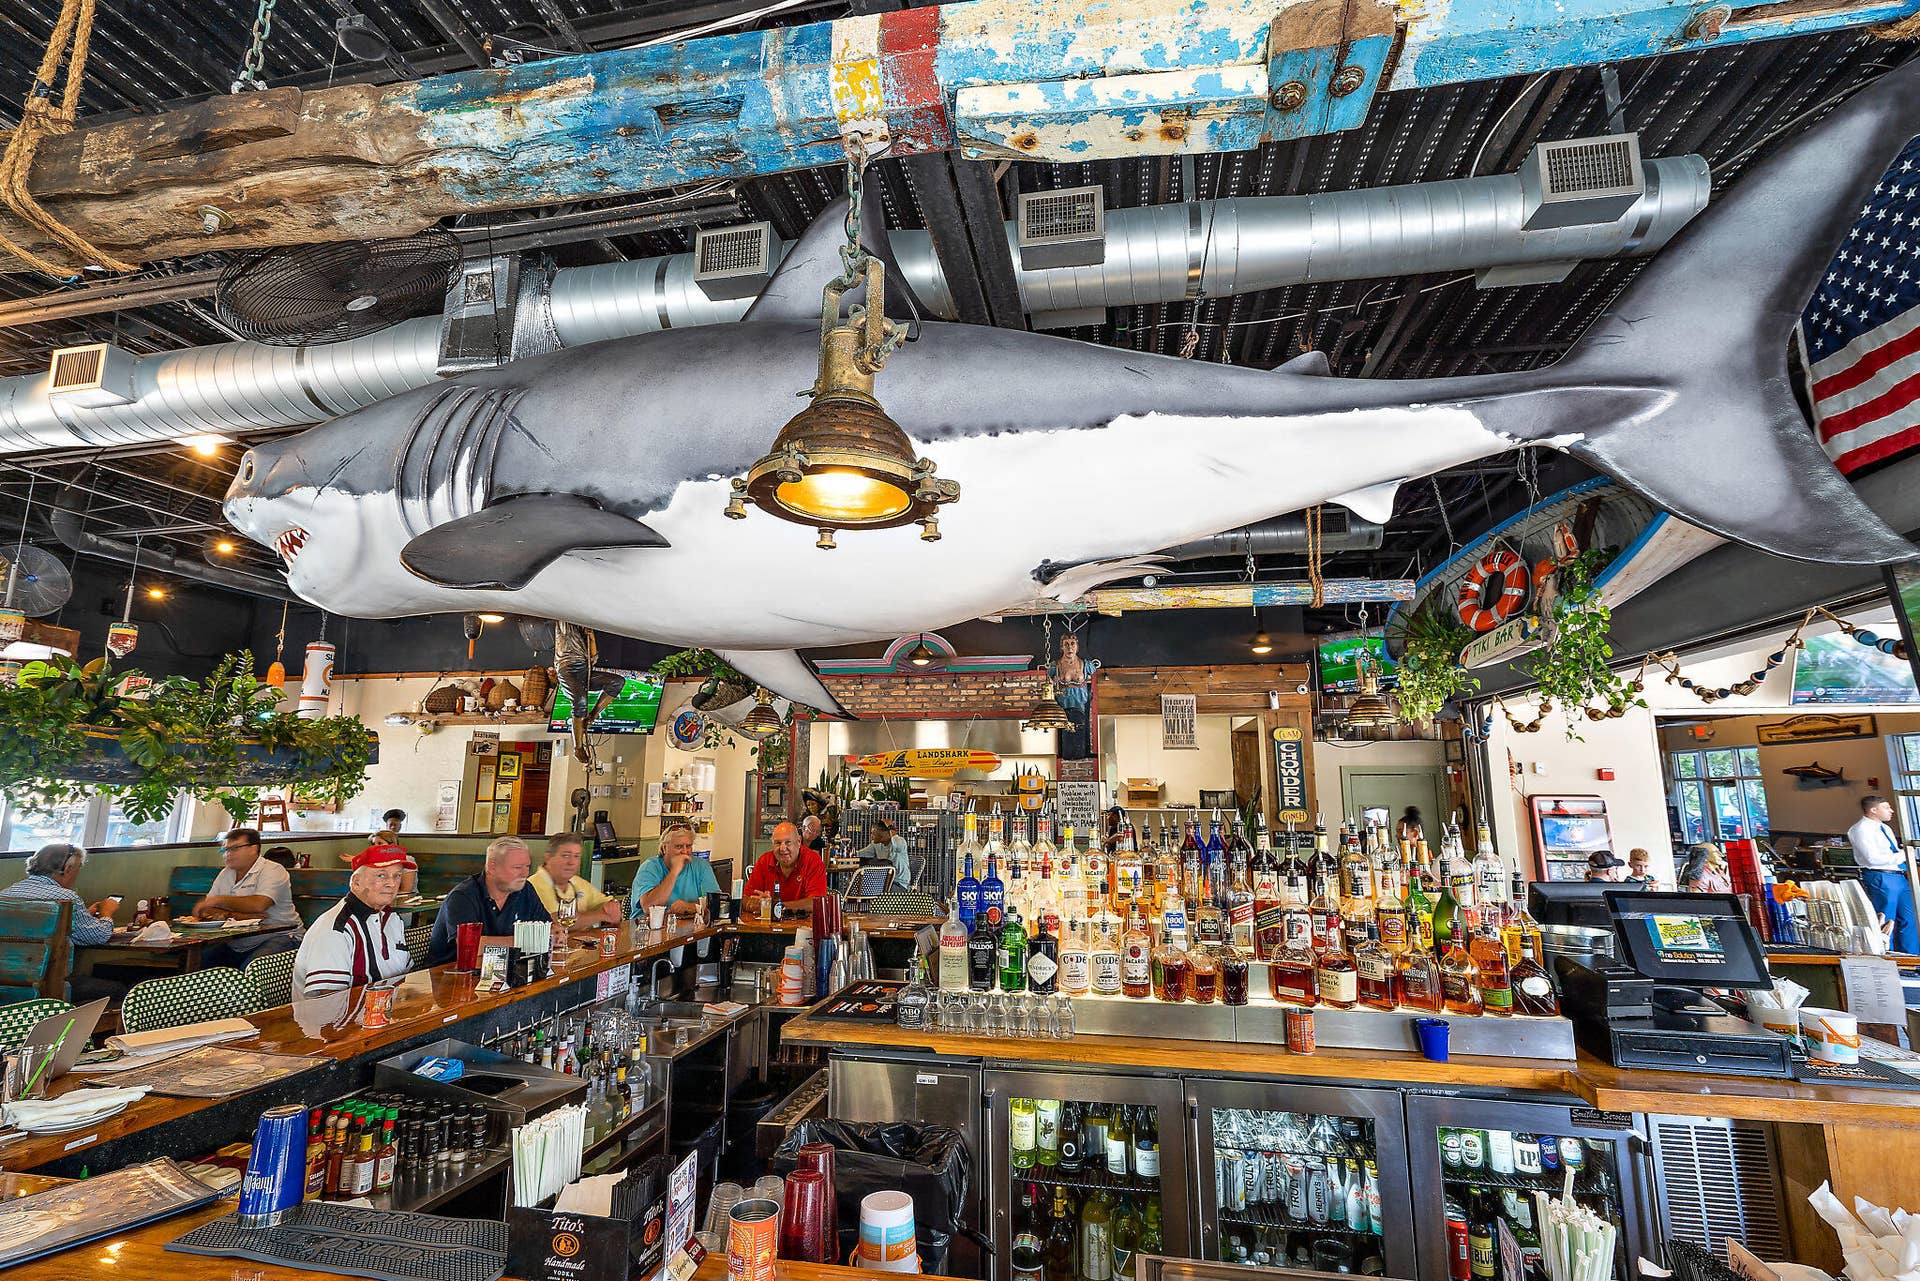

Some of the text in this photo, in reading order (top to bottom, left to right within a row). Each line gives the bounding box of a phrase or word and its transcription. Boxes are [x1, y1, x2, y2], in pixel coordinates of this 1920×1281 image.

[1472, 625, 1514, 657] TIKI BAR
[1164, 706, 1194, 714] HAPPINESS
[1165, 719, 1194, 734] WINE
[1279, 730, 1299, 738] CLAM
[916, 750, 969, 758] LANDSHARK
[1280, 742, 1301, 807] CHOWDER
[984, 890, 1004, 900] SKYY
[900, 1007, 920, 1015] CABO
[1602, 1112, 1631, 1121] Services
[1246, 1160, 1254, 1192] TRULY
[1266, 1159, 1274, 1192] TRULY
[1290, 1178, 1299, 1209] TRULY
[544, 1256, 586, 1271] Handmade
[554, 1270, 574, 1278] VODKA
